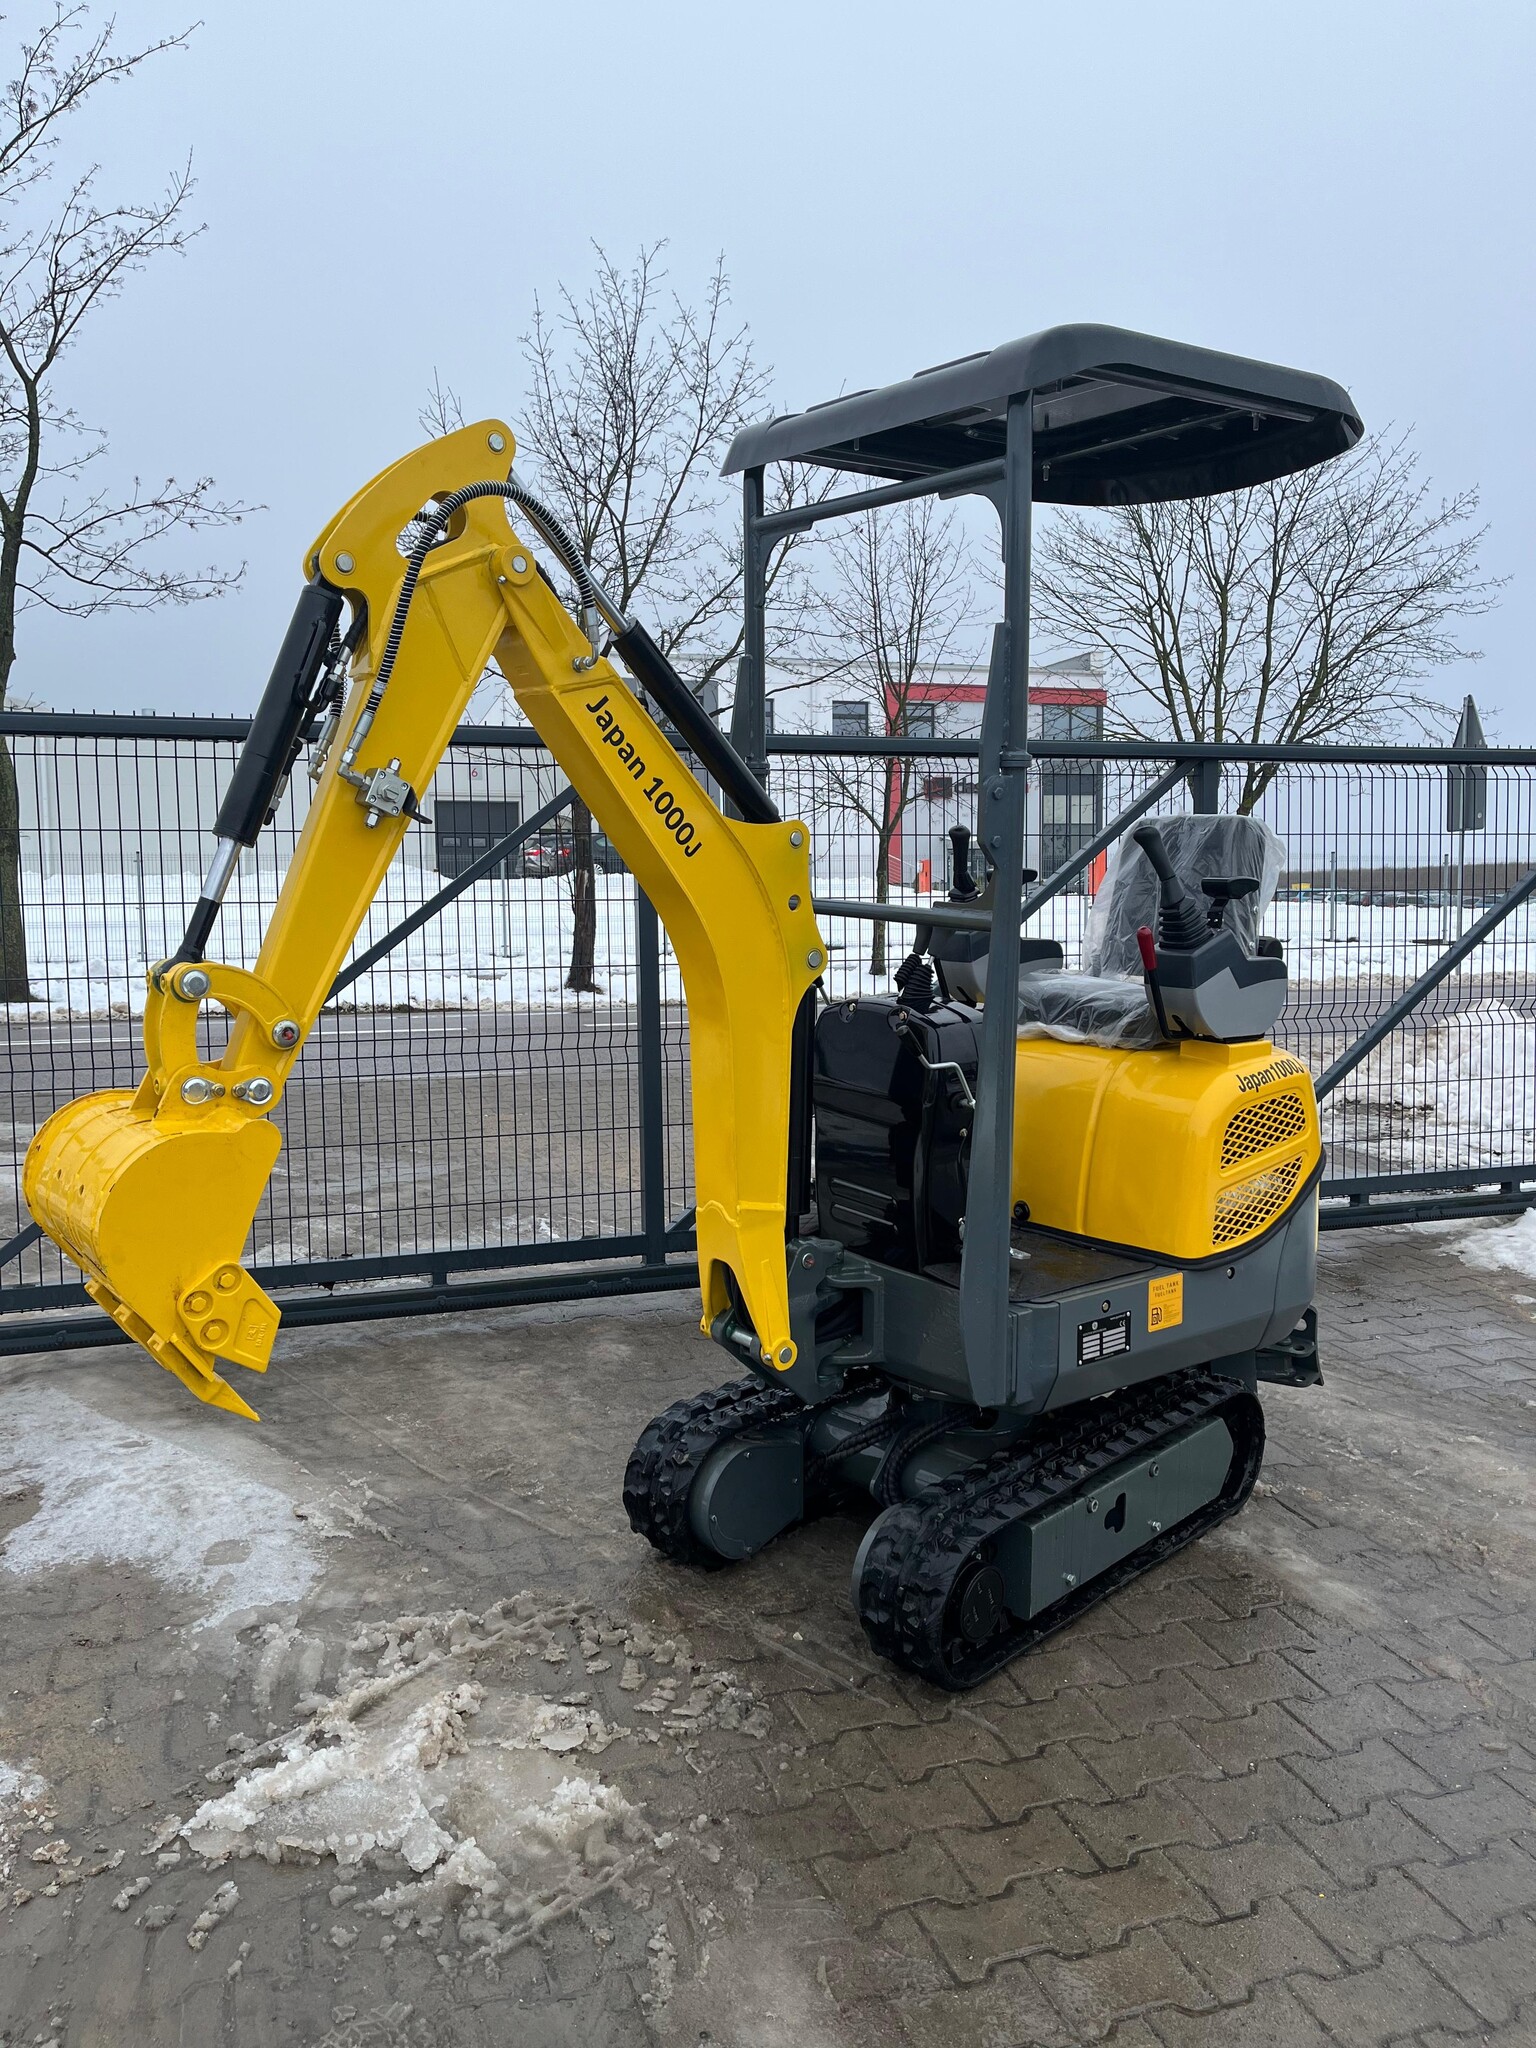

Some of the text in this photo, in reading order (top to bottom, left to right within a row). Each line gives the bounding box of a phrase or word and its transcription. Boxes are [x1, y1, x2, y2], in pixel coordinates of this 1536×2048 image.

[585, 695, 702, 858] Japan 1000J
[1153, 1285, 1165, 1293] FUEL
